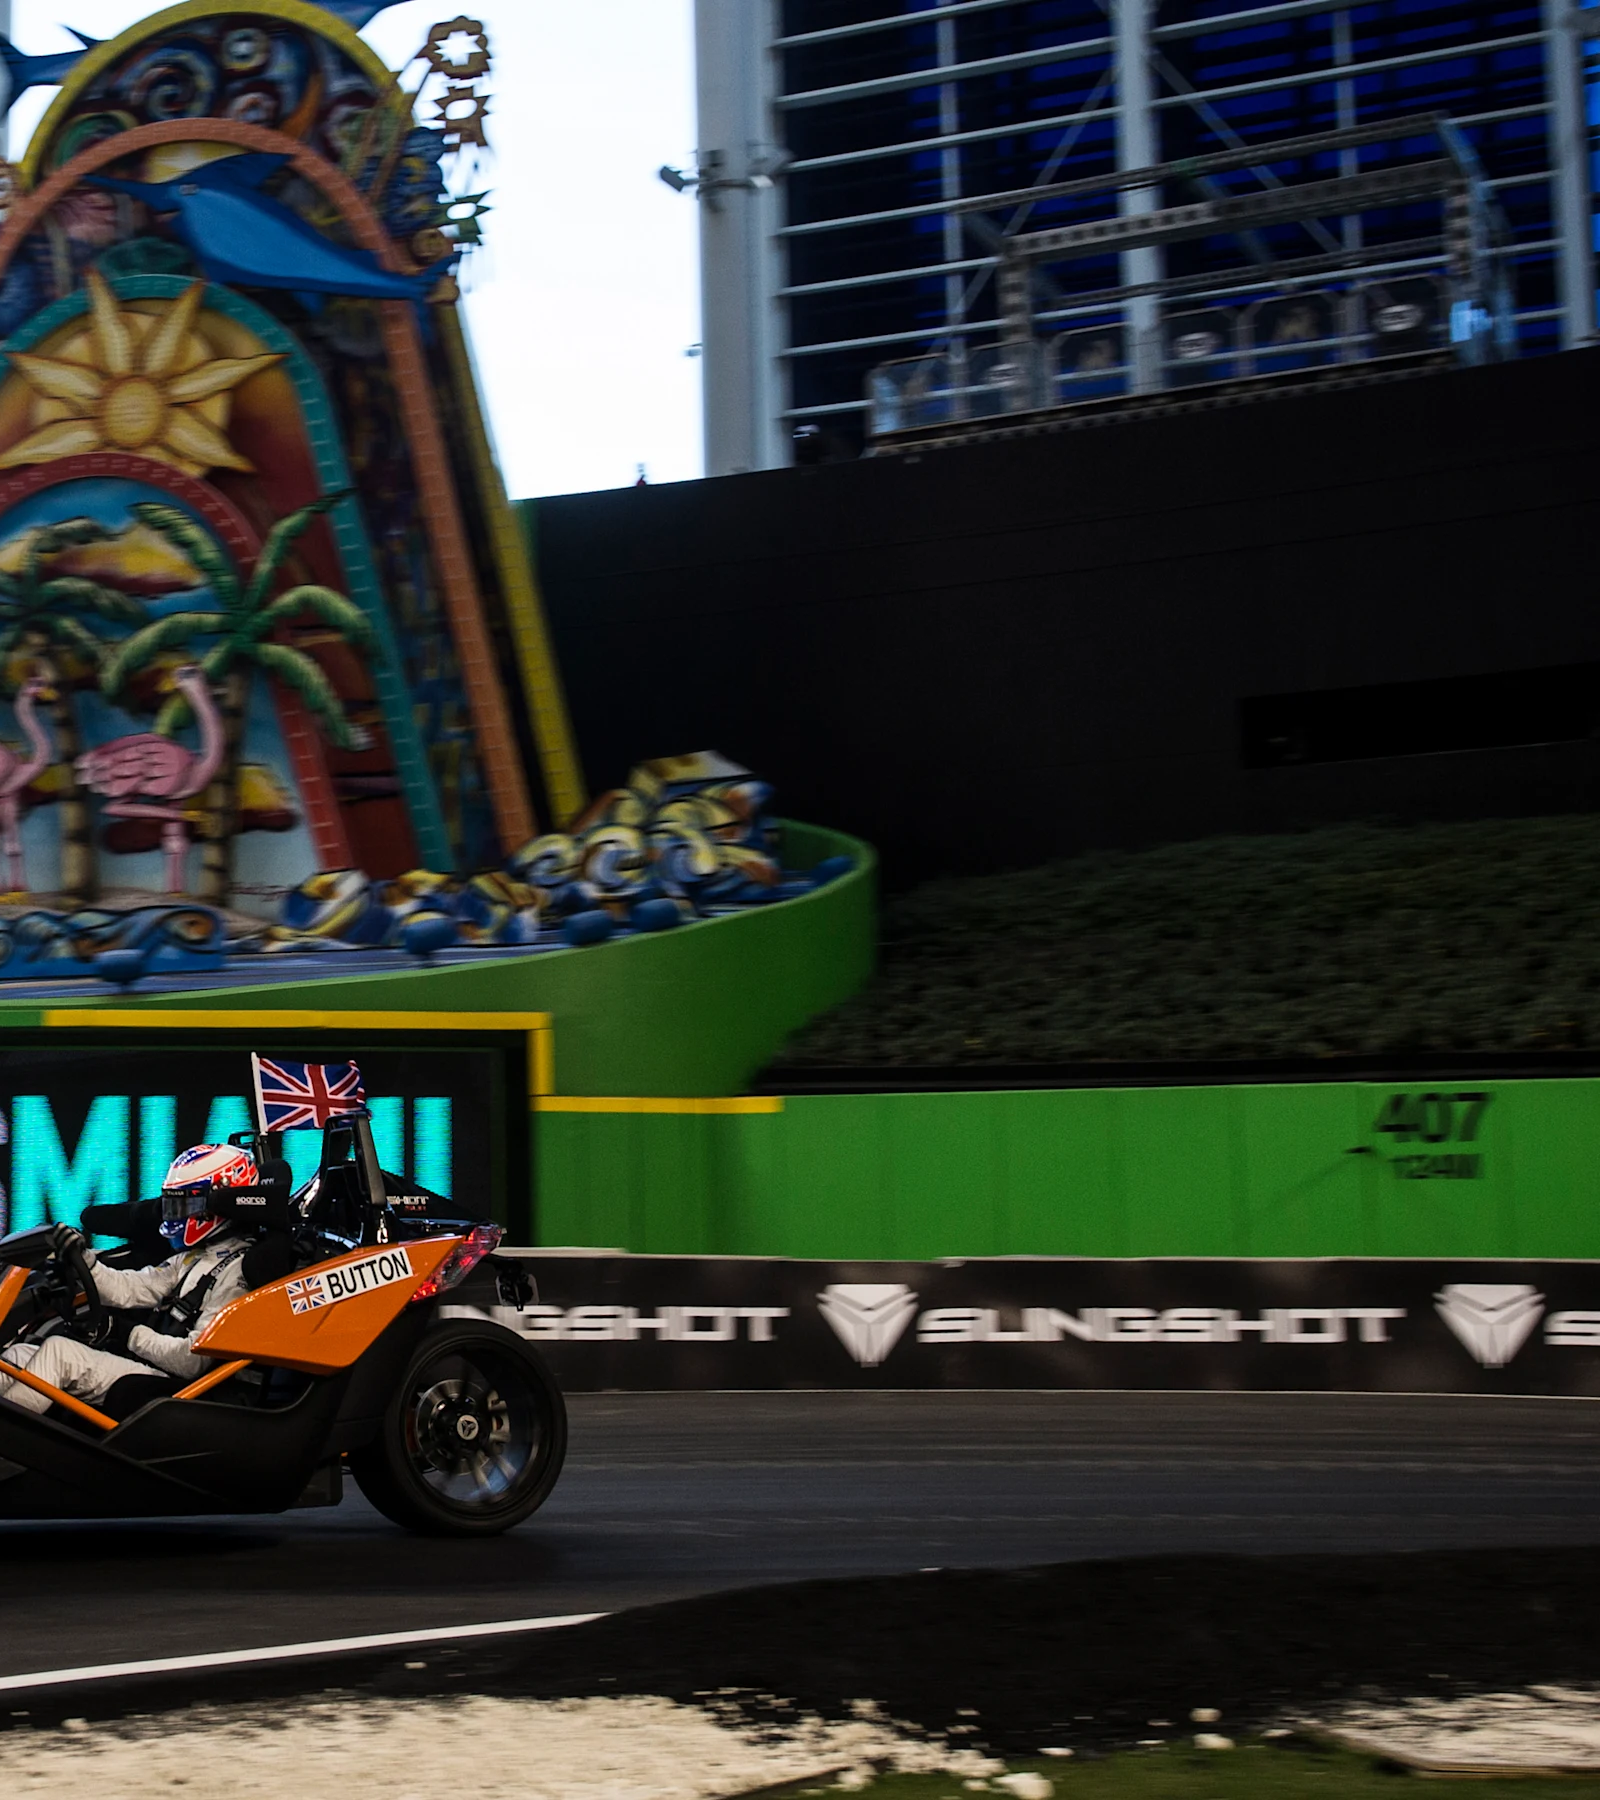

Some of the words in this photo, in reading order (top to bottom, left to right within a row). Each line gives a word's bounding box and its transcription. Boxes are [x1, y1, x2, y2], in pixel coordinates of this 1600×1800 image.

[1374, 1092, 1492, 1142] 407
[327, 1251, 409, 1298] BUTTON
[917, 1307, 1405, 1343] SLINGSHOT
